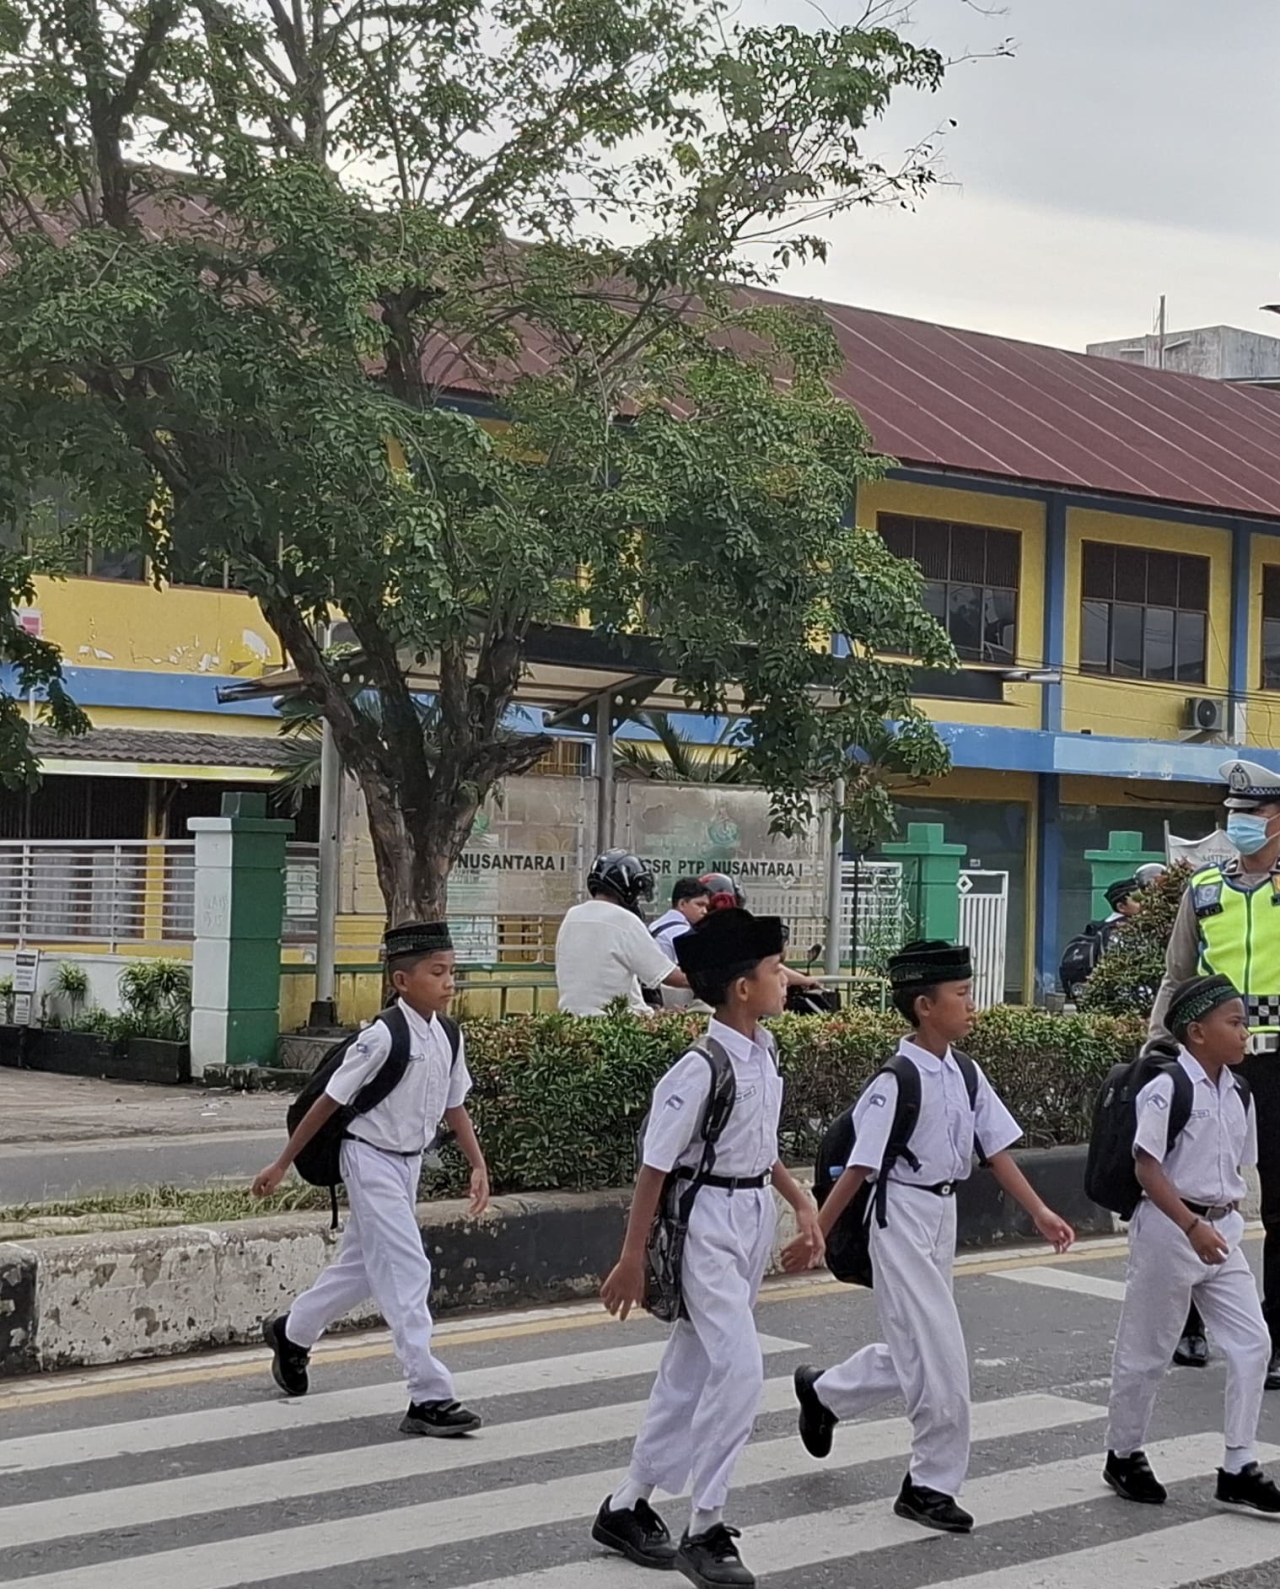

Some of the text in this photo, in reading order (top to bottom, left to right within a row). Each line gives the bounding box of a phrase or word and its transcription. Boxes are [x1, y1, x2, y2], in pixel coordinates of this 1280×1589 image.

[457, 853, 565, 871] NUSANTARA I
[678, 860, 704, 875] PTP
[712, 861, 794, 877] NUSANTARA
[799, 863, 803, 877] I
